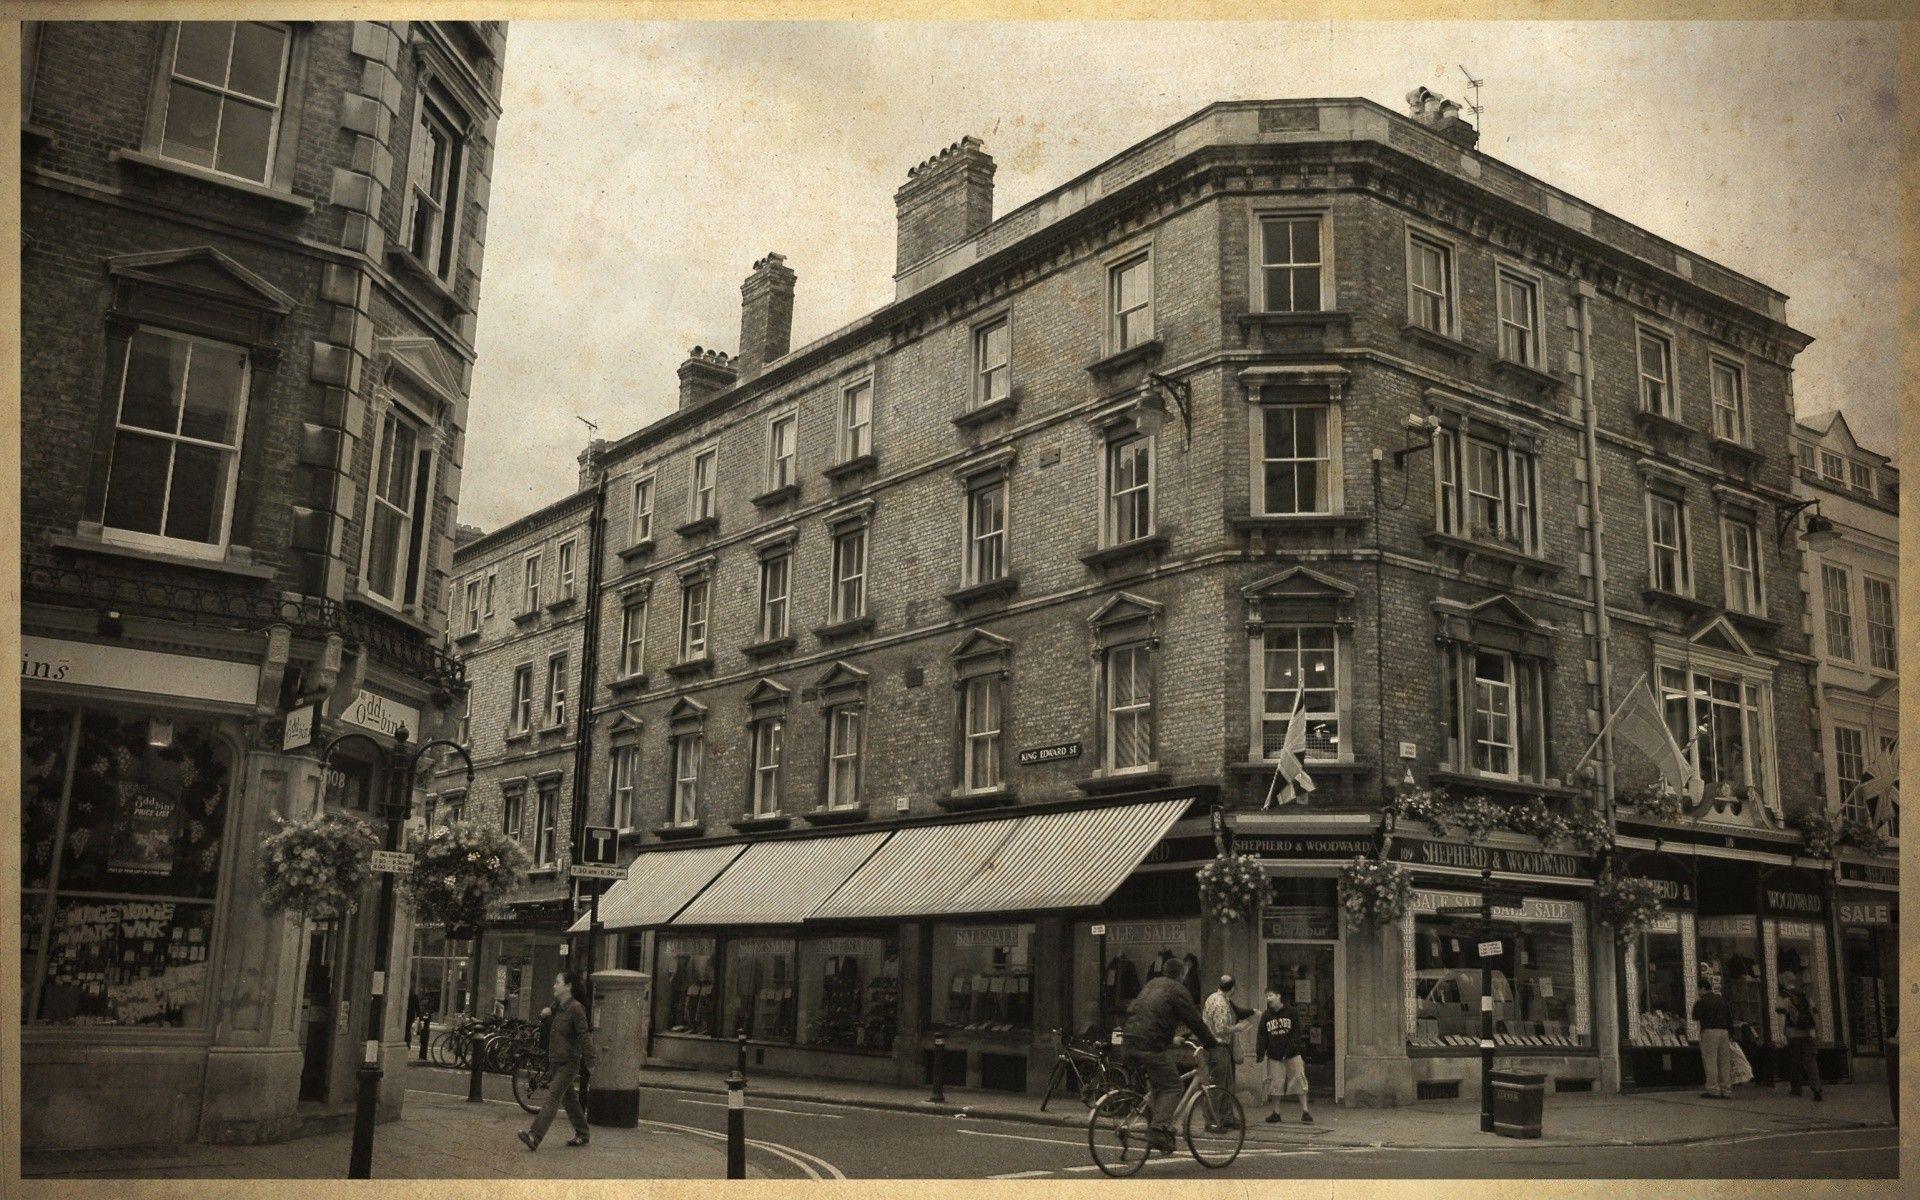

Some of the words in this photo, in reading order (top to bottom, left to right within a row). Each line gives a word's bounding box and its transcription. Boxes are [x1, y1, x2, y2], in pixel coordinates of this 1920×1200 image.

[357, 696, 400, 736] Oddbin
[1021, 751, 1037, 762] KING
[1040, 747, 1067, 758] EDWARD
[1069, 745, 1077, 754] ST
[1234, 839, 1292, 851] SHEPHERD
[1295, 841, 1302, 851] &
[1305, 840, 1371, 852] WOODWARD
[1422, 841, 1488, 868] SHEPHERD
[1492, 851, 1503, 870] &
[1505, 850, 1577, 875] WOODWARD
[1454, 895, 1478, 908] SAL
[1534, 903, 1568, 919] SALE
[1767, 889, 1821, 912] WOODWARD
[1840, 905, 1888, 923] SALE
[1107, 926, 1135, 941] ALE
[1143, 924, 1182, 941] SALE
[1697, 919, 1751, 935] SALE
[1779, 920, 1810, 937] SALE
[956, 930, 986, 944] SALE
[987, 928, 1018, 943] SALE
